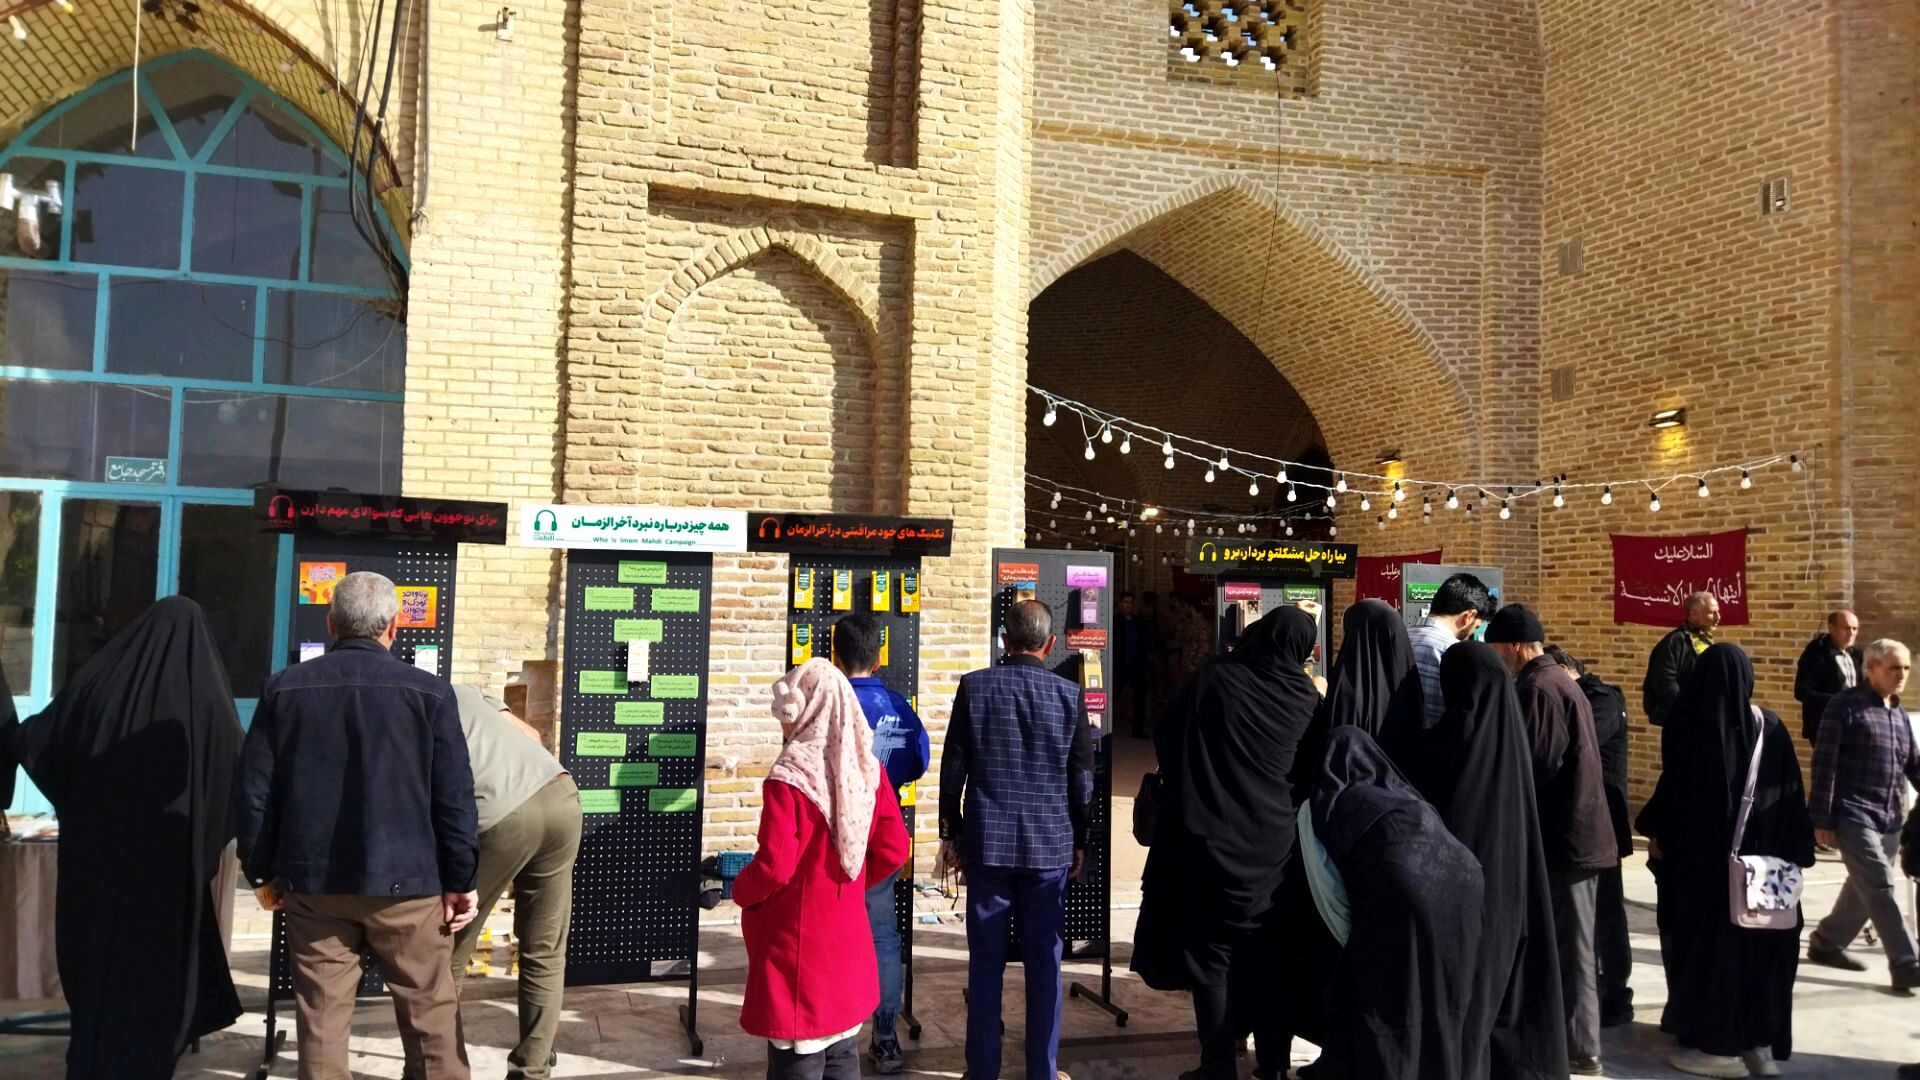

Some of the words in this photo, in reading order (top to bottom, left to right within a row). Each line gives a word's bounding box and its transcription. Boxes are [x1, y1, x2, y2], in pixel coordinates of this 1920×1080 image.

[109, 462, 133, 481] جامع
[144, 461, 166, 481] دفتر
[299, 503, 326, 518] دارن
[327, 505, 350, 518] مهم
[351, 504, 389, 520] سوالای
[390, 507, 404, 519] که
[404, 509, 433, 523] هایی
[476, 513, 499, 527] برای
[571, 515, 632, 531] آخرالزمان
[632, 517, 654, 532] نبرد
[654, 518, 689, 533] درباره
[708, 520, 730, 532] همه
[688, 520, 707, 536] چیز
[786, 522, 831, 538] آخرالزمان
[829, 526, 842, 538] در
[842, 523, 877, 539] مراقبتی
[877, 527, 897, 539] خود
[897, 527, 915, 540] های
[916, 527, 945, 541] تکنیک
[665, 538, 696, 547] Campaign
[1267, 546, 1304, 562] مشکلتو
[1305, 548, 1320, 563] حل
[1321, 548, 1334, 564] راه
[1334, 548, 1347, 564] بیا
